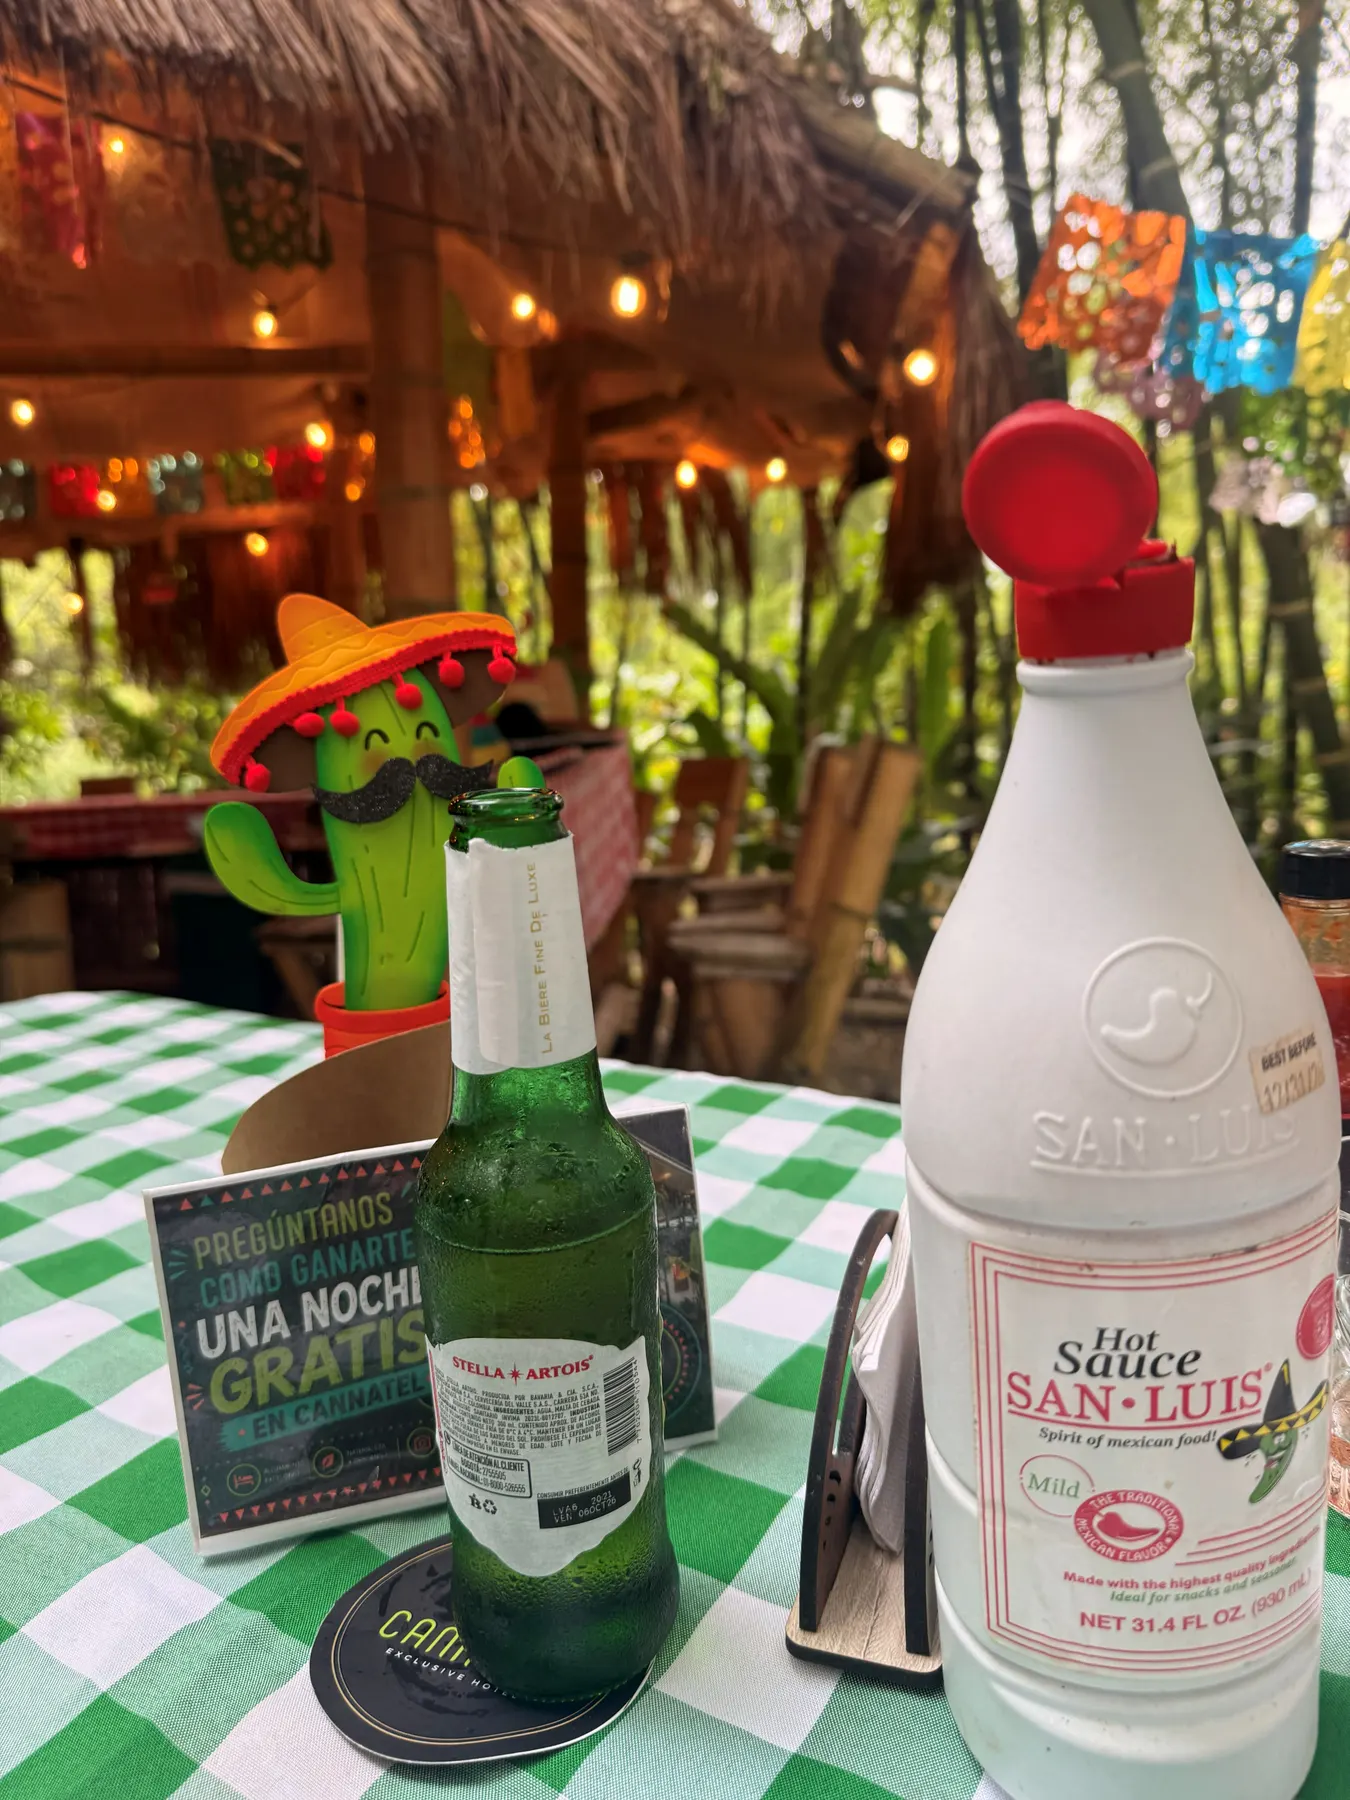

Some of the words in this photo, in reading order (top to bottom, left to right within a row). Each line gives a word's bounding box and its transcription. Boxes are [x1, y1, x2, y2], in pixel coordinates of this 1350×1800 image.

[527, 862, 539, 904] LUXE
[530, 911, 542, 933] DE
[534, 940, 546, 975] FINE
[1261, 1048, 1286, 1073] BEST
[1288, 1031, 1317, 1061] BEFORE
[194, 1192, 393, 1270] PREGÚNTANOS
[291, 1228, 416, 1287] GANARTE
[197, 1300, 291, 1359] UNA
[1092, 1326, 1160, 1352] Hot
[210, 1309, 427, 1414] GRATIS
[452, 1356, 505, 1379] STELLA
[1053, 1341, 1201, 1379] Sauce
[252, 1410, 287, 1439] EN
[295, 1371, 425, 1426] CANNATEL
[530, 1393, 553, 1401] BAVARIA
[554, 1396, 578, 1406] CARRERA
[555, 1403, 572, 1412] MALTA
[570, 1402, 600, 1416] INDUSTRIA
[536, 1425, 565, 1435] MANTENER
[550, 1440, 563, 1448] LOTE
[575, 1434, 592, 1443] FECHA
[1039, 1427, 1083, 1443] Spirit
[1086, 1434, 1105, 1449] of
[1107, 1435, 1173, 1448] mexican
[1175, 1430, 1217, 1450] food!
[501, 1461, 524, 1472] CLIENTE
[537, 1490, 564, 1499] CONSUMIR
[565, 1478, 609, 1495] PREFERENTEMENTE
[1027, 1472, 1080, 1499] Mild
[554, 1513, 573, 1523] VEN
[1088, 1493, 1116, 1509] THE
[1117, 1491, 1180, 1536] TRADITIONAL
[1076, 1517, 1117, 1559] MEXICAN
[1118, 1542, 1168, 1561] FLAVOR
[1063, 1571, 1104, 1587] Made
[1107, 1578, 1139, 1590] with
[1142, 1579, 1167, 1589] the
[1170, 1573, 1221, 1590] highest
[1224, 1559, 1266, 1580] quality
[1110, 1590, 1146, 1602] Ideal
[1147, 1591, 1171, 1606] for
[1174, 1586, 1219, 1602] snacks
[1223, 1577, 1249, 1594] and
[1080, 1611, 1126, 1631] NET
[1131, 1617, 1176, 1633] 31.4
[1182, 1614, 1207, 1631] FL
[1252, 1587, 1286, 1618] (930
[379, 1610, 471, 1667] CAN
[385, 1647, 466, 1680] EXCLUSIVE
